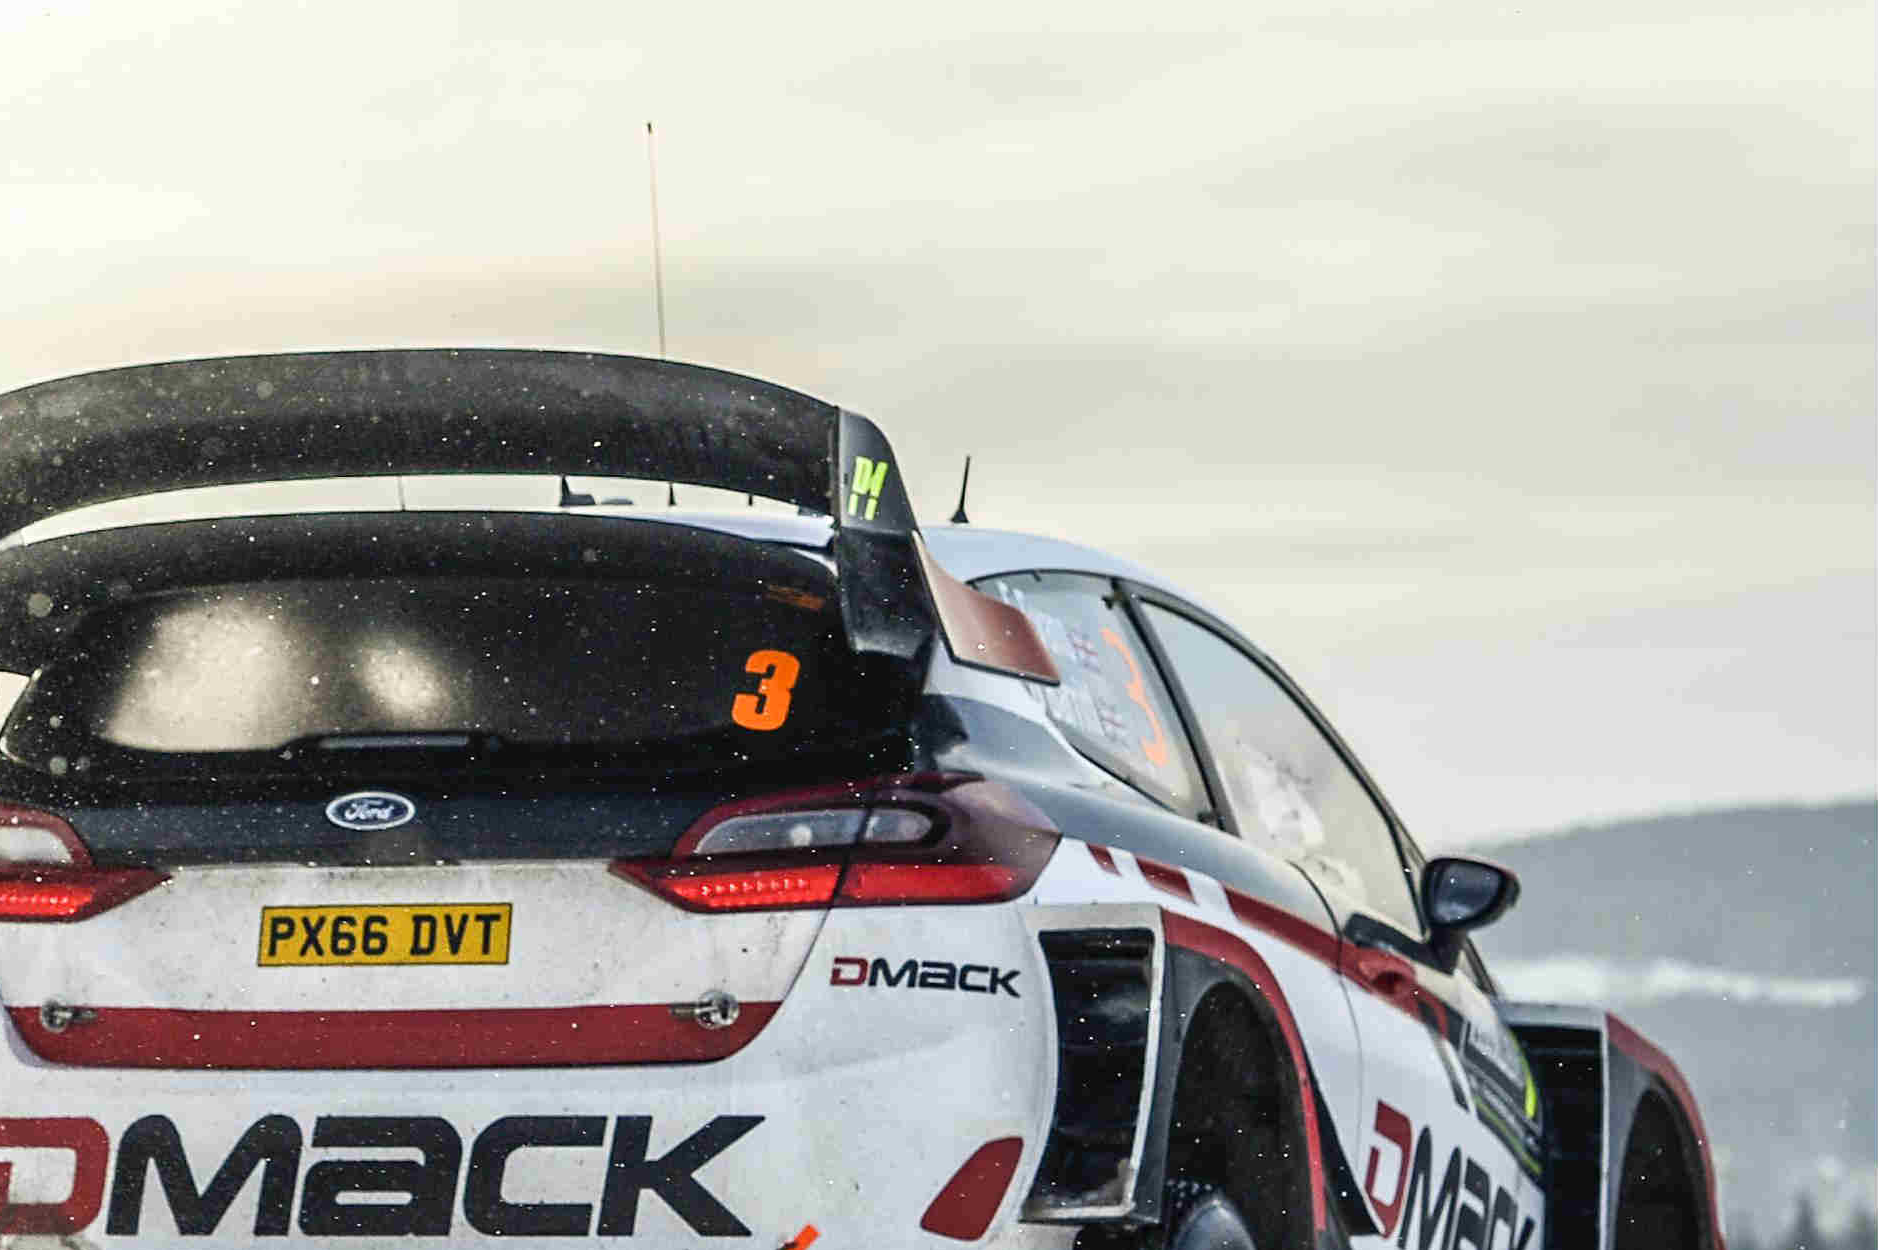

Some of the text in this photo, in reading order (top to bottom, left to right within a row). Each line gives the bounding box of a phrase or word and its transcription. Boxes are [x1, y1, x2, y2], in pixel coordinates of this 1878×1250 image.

[730, 648, 802, 736] 3
[344, 799, 395, 821] Ford
[267, 913, 502, 957] PX66 DVT
